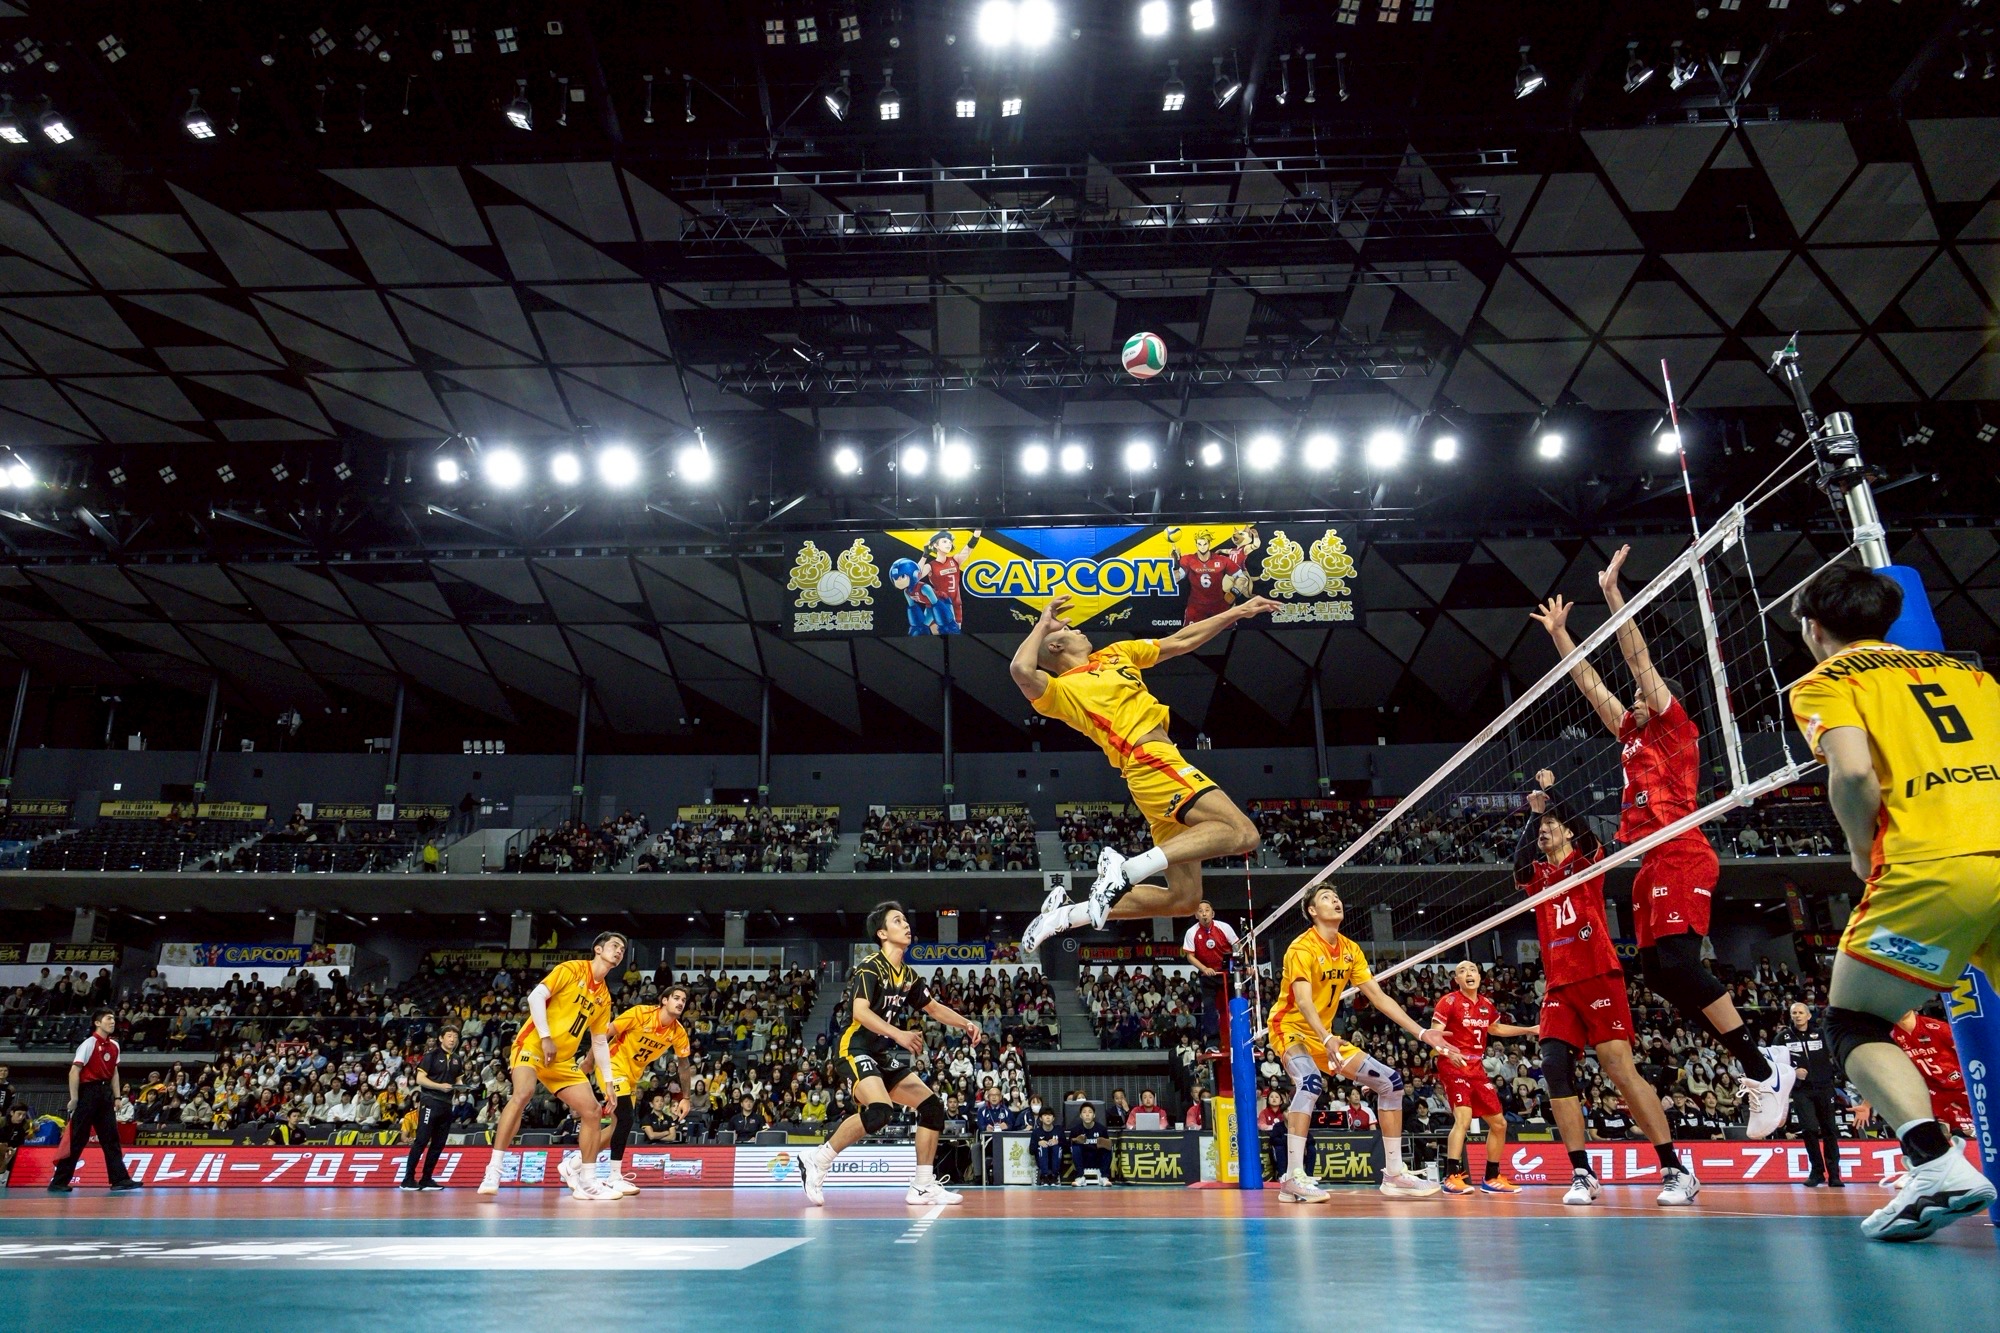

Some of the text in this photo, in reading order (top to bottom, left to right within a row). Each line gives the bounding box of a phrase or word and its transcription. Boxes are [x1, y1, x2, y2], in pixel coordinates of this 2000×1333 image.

[963, 558, 1179, 597] CAPCOM
[1200, 574, 1212, 588] 6
[1907, 683, 1974, 744] 6
[1193, 773, 1205, 782] 9
[1049, 873, 1065, 888] 東
[1552, 896, 1577, 929] 10
[225, 947, 302, 963] CAPCOM
[911, 944, 987, 961] CAPCOM
[1870, 941, 1940, 971] ワークスタッフ
[1327, 984, 1337, 1008] 1
[568, 1010, 588, 1038] 10
[638, 1036, 665, 1049] JTEKT
[633, 1047, 654, 1062] 23
[860, 1061, 873, 1072] 21
[1916, 1057, 1943, 1076] 15
[1455, 1093, 1463, 1103] 3
[1318, 1112, 1326, 1124] 2
[1972, 1083, 1998, 1163] Senoh
[828, 1158, 890, 1173] ureLab
[1515, 1173, 1547, 1181] CLEVER
